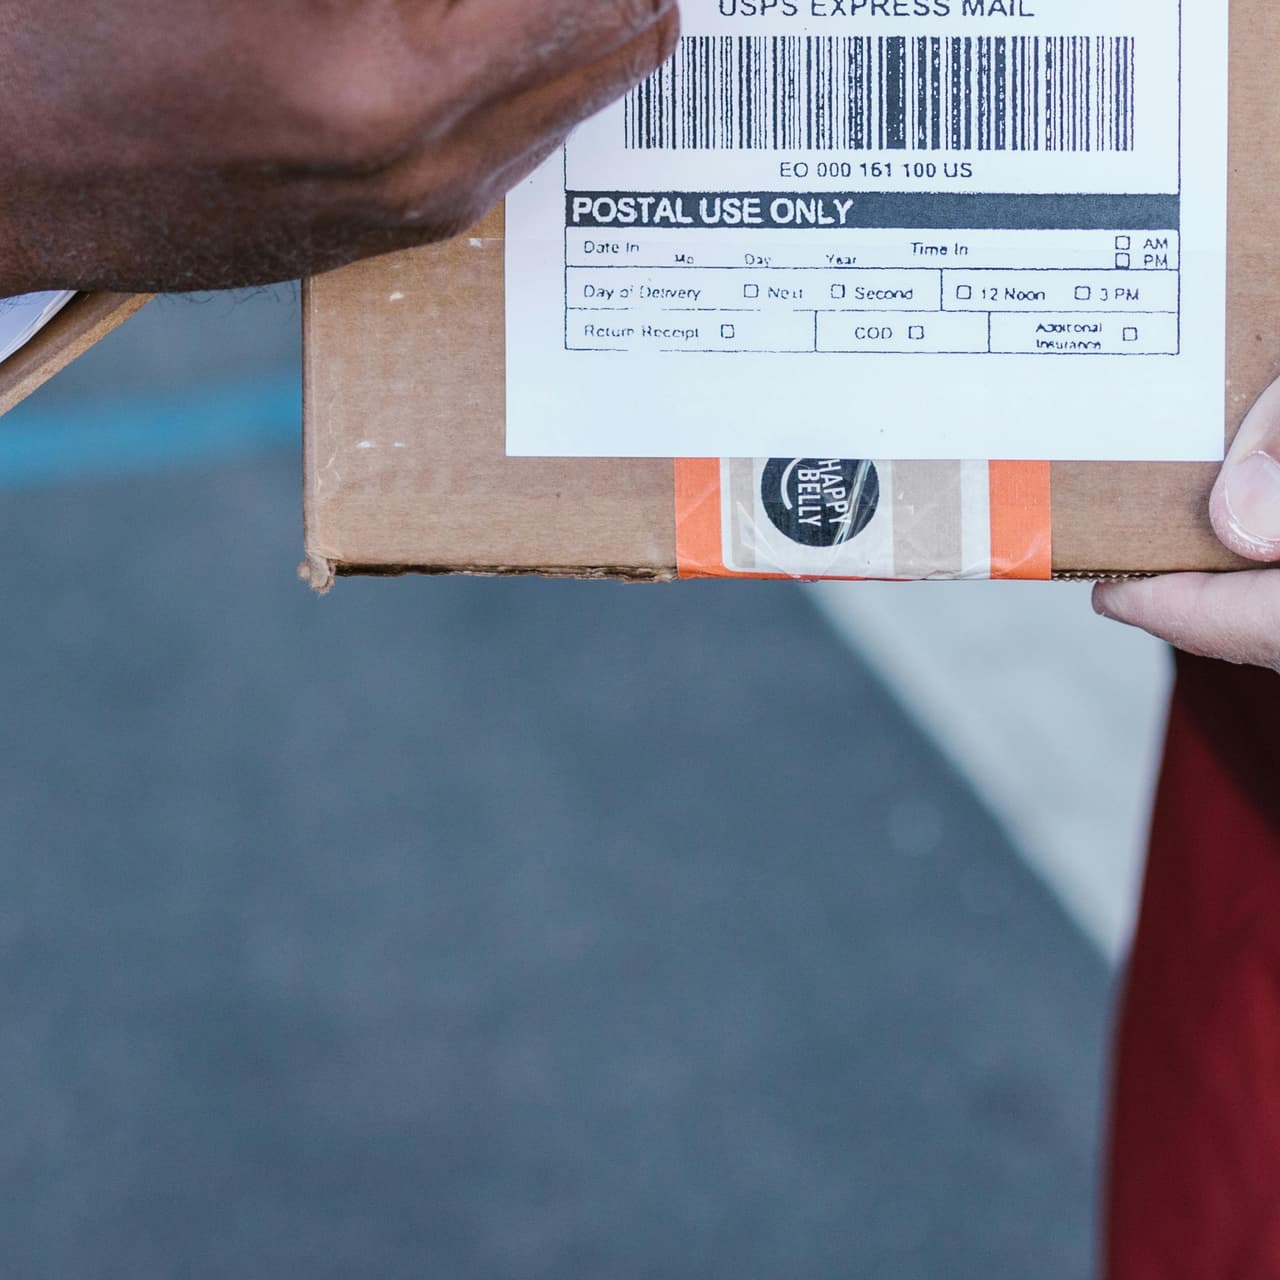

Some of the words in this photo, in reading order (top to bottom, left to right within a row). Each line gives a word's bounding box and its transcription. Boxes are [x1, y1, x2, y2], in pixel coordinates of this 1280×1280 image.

[779, 161, 809, 178] EO
[816, 161, 852, 178] 000
[859, 161, 892, 178] 161
[903, 162, 937, 178] 100
[943, 162, 973, 178] US
[572, 196, 694, 224] POSTAL
[699, 197, 764, 224] USE
[769, 197, 854, 225] ONLY
[583, 240, 620, 254] Date
[626, 242, 640, 253] In
[910, 241, 948, 256] Time
[954, 242, 969, 256] In
[1142, 237, 1169, 250] AM
[1143, 253, 1169, 270] PM
[583, 284, 615, 301] Day
[639, 285, 701, 302] Delivery
[854, 286, 914, 301] Second
[981, 287, 998, 302] 12
[1004, 287, 1046, 301] Noon
[1099, 287, 1109, 302] 3
[1114, 287, 1139, 301] PM
[584, 324, 635, 338] Return
[642, 325, 699, 341] Receipt
[854, 326, 893, 340] COD
[797, 469, 822, 527] BELLY
[818, 459, 851, 523] HAPPY
